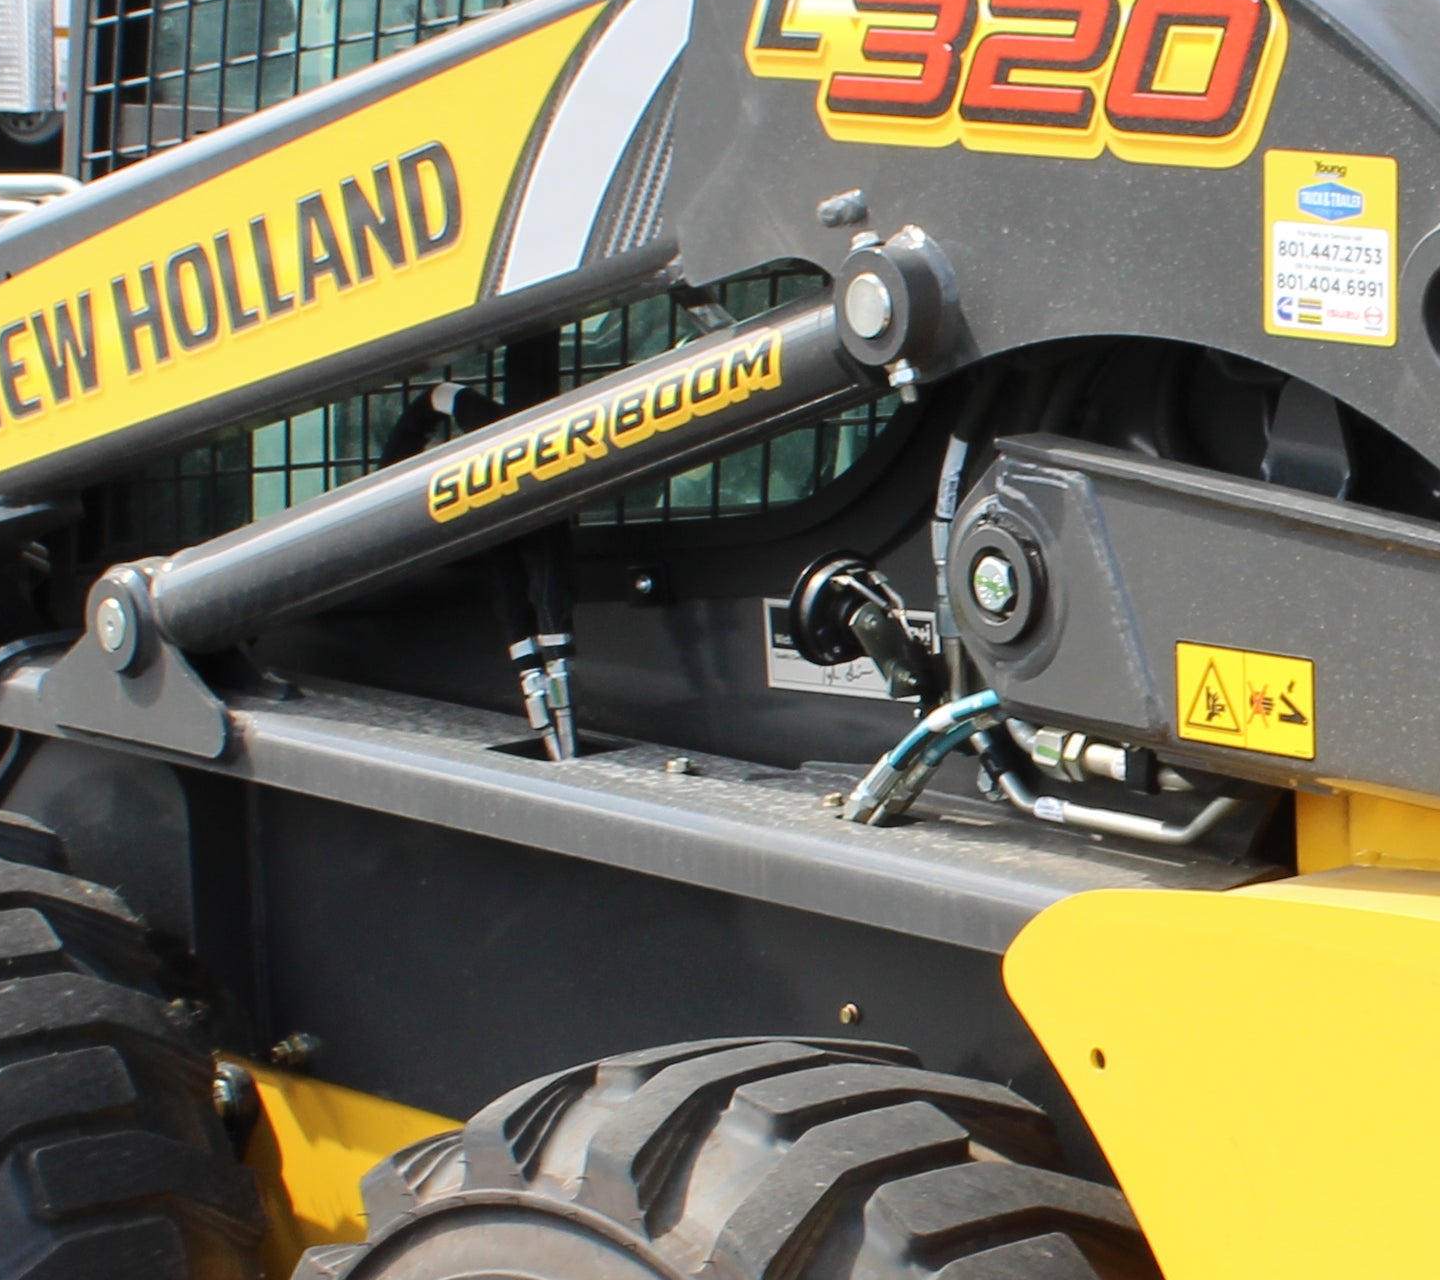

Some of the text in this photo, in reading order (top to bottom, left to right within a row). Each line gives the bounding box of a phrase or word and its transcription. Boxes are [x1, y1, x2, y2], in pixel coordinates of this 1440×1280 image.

[1314, 160, 1348, 179] Young
[110, 140, 462, 376] HOLLAND
[1277, 239, 1383, 265] 801.447.2753
[1276, 272, 1385, 298] 801.404.6991
[428, 333, 778, 518] SUPER BOOM
